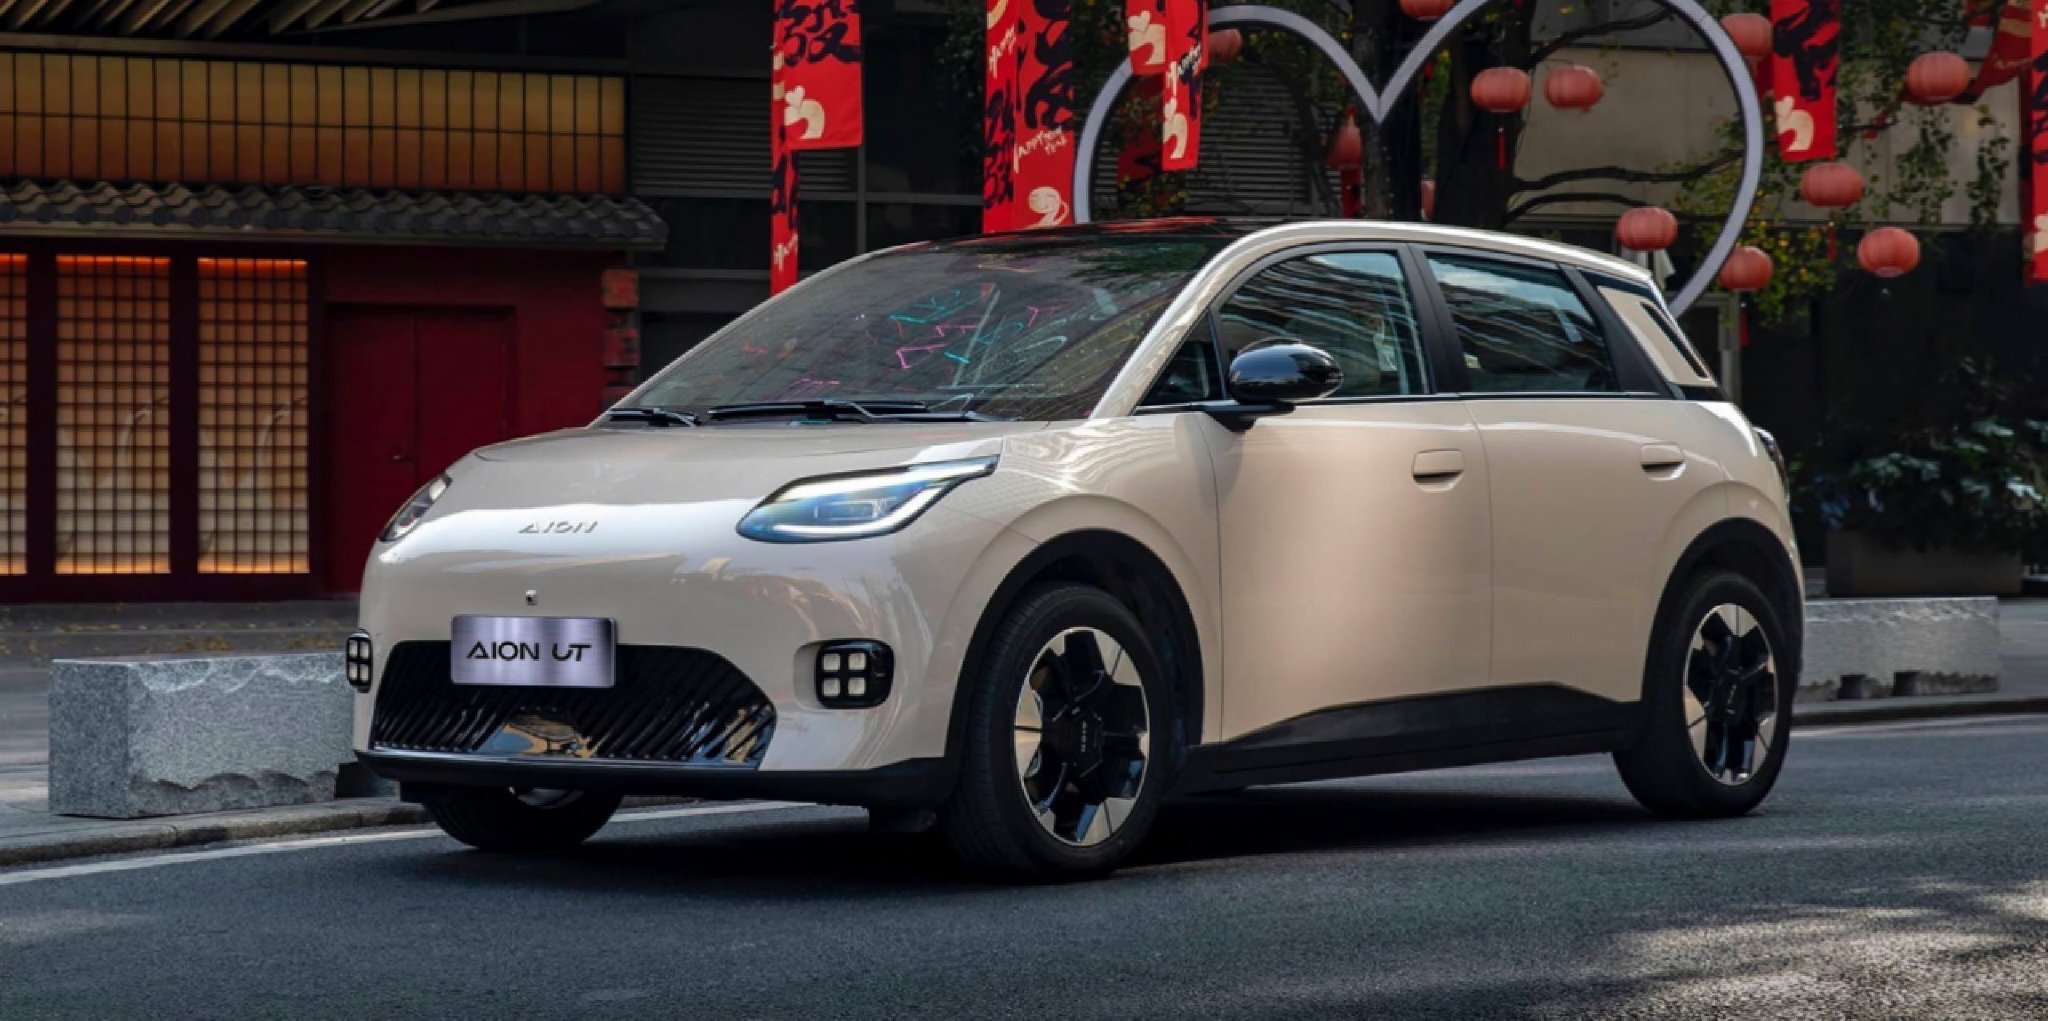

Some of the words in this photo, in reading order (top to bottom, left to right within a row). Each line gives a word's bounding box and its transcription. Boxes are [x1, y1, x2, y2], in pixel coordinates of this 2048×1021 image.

[518, 521, 598, 534] AION
[466, 641, 540, 662] AION
[551, 642, 593, 662] UT
